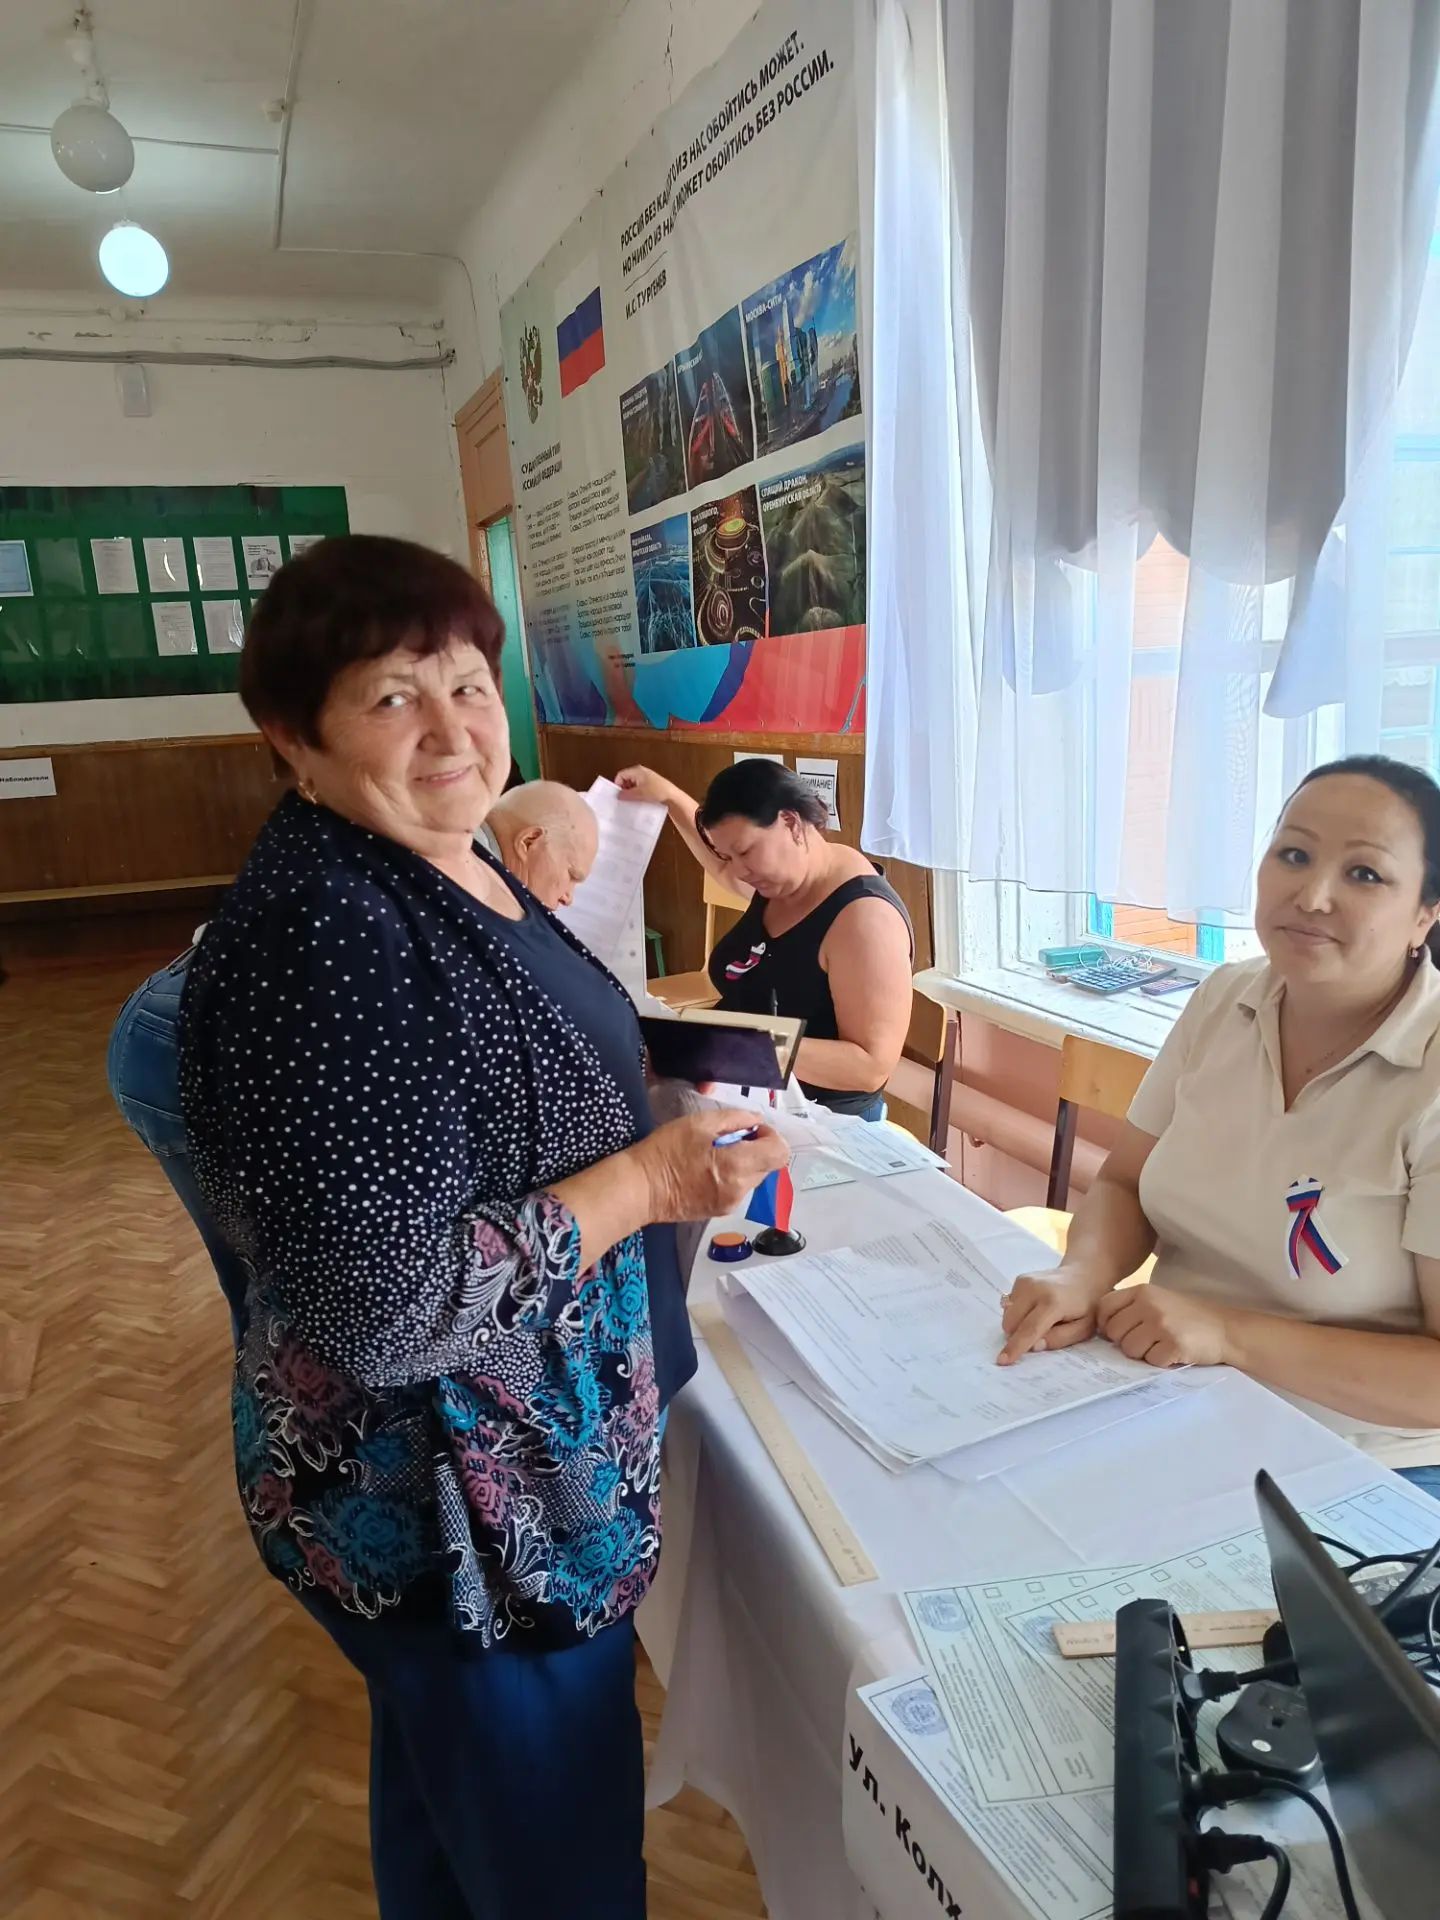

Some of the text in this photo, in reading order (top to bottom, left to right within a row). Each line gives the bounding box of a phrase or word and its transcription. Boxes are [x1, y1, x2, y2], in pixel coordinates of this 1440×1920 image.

[622, 256, 632, 277] НО
[631, 234, 653, 267] НИКТО
[653, 224, 662, 247] ИЗ
[705, 122, 755, 183] ОБОЙТИСЬ
[755, 99, 776, 135] БЕЗ
[776, 49, 834, 114] РОССИИ.
[644, 201, 656, 226] БЕЗ
[676, 152, 688, 176] ИЗ
[689, 130, 707, 165] НАС
[706, 79, 758, 144] ОБОЙТИСЬ
[759, 30, 804, 91] МОЖЕТ.
[636, 269, 667, 309] ТУРГЕНЕВ
